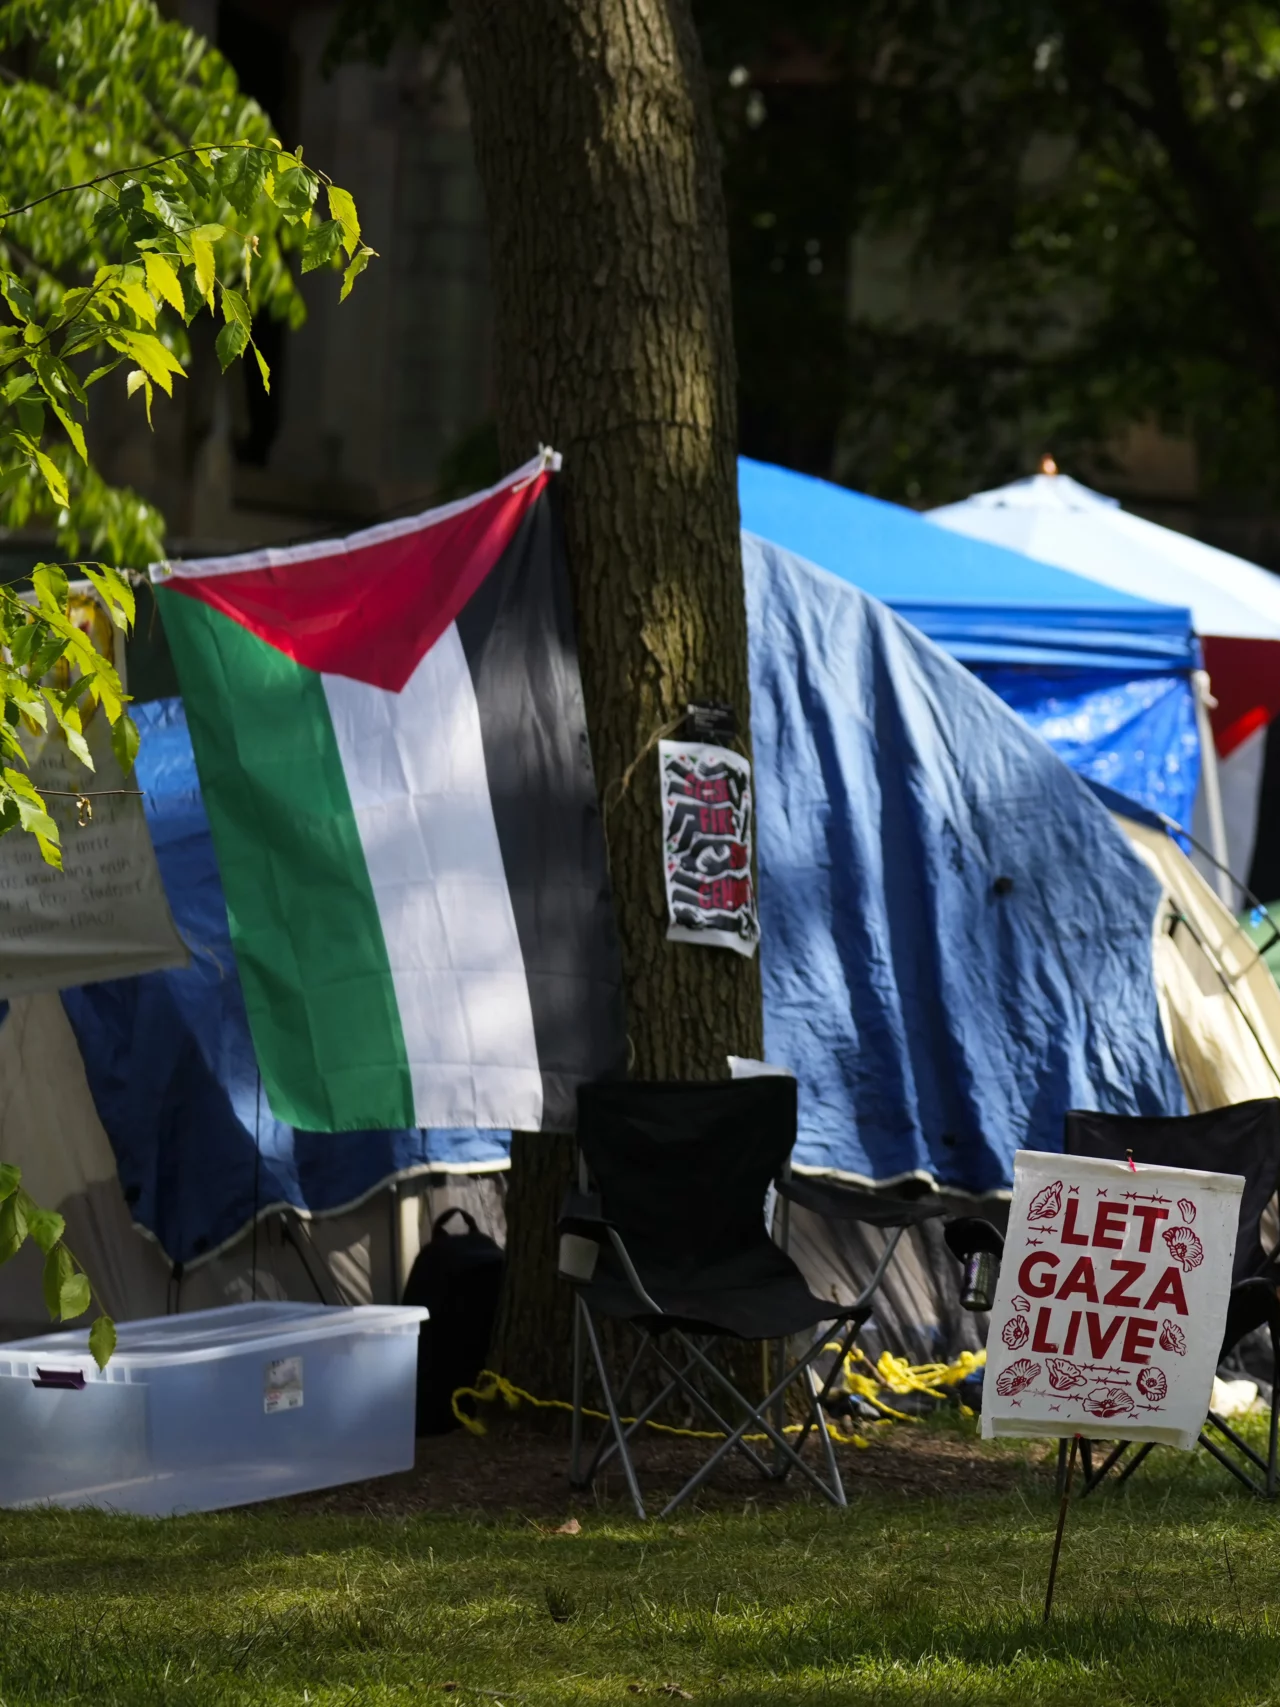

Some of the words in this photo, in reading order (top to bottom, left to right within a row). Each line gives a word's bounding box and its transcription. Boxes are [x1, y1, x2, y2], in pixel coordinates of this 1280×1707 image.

[1060, 1197, 1170, 1254] LET
[1017, 1250, 1189, 1316] GAZA
[1031, 1306, 1158, 1366] LIVE
